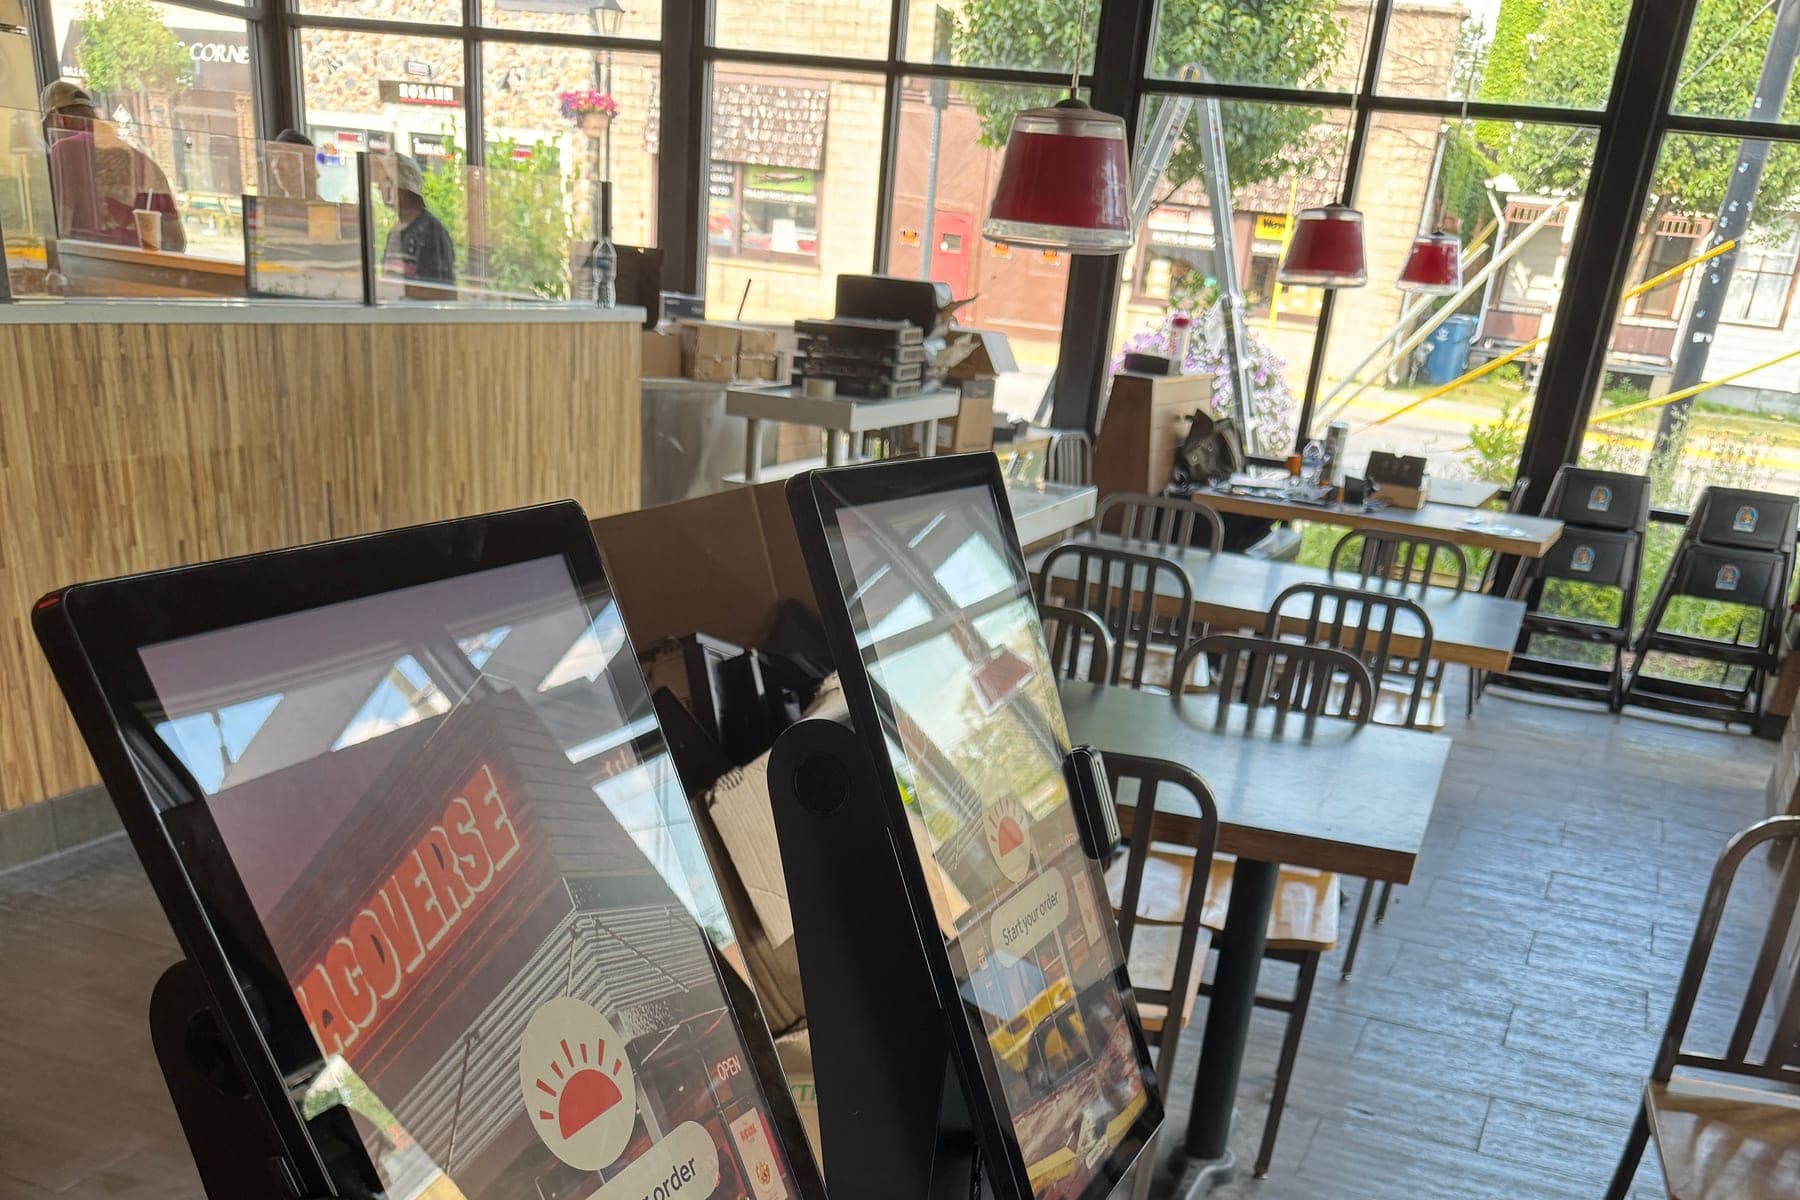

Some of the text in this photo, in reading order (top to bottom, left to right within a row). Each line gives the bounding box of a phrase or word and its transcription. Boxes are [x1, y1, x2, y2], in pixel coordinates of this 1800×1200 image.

[296, 764, 520, 1062] ACOVERSE
[1002, 892, 1058, 946] Start your order
[716, 1056, 742, 1081] OPEN
